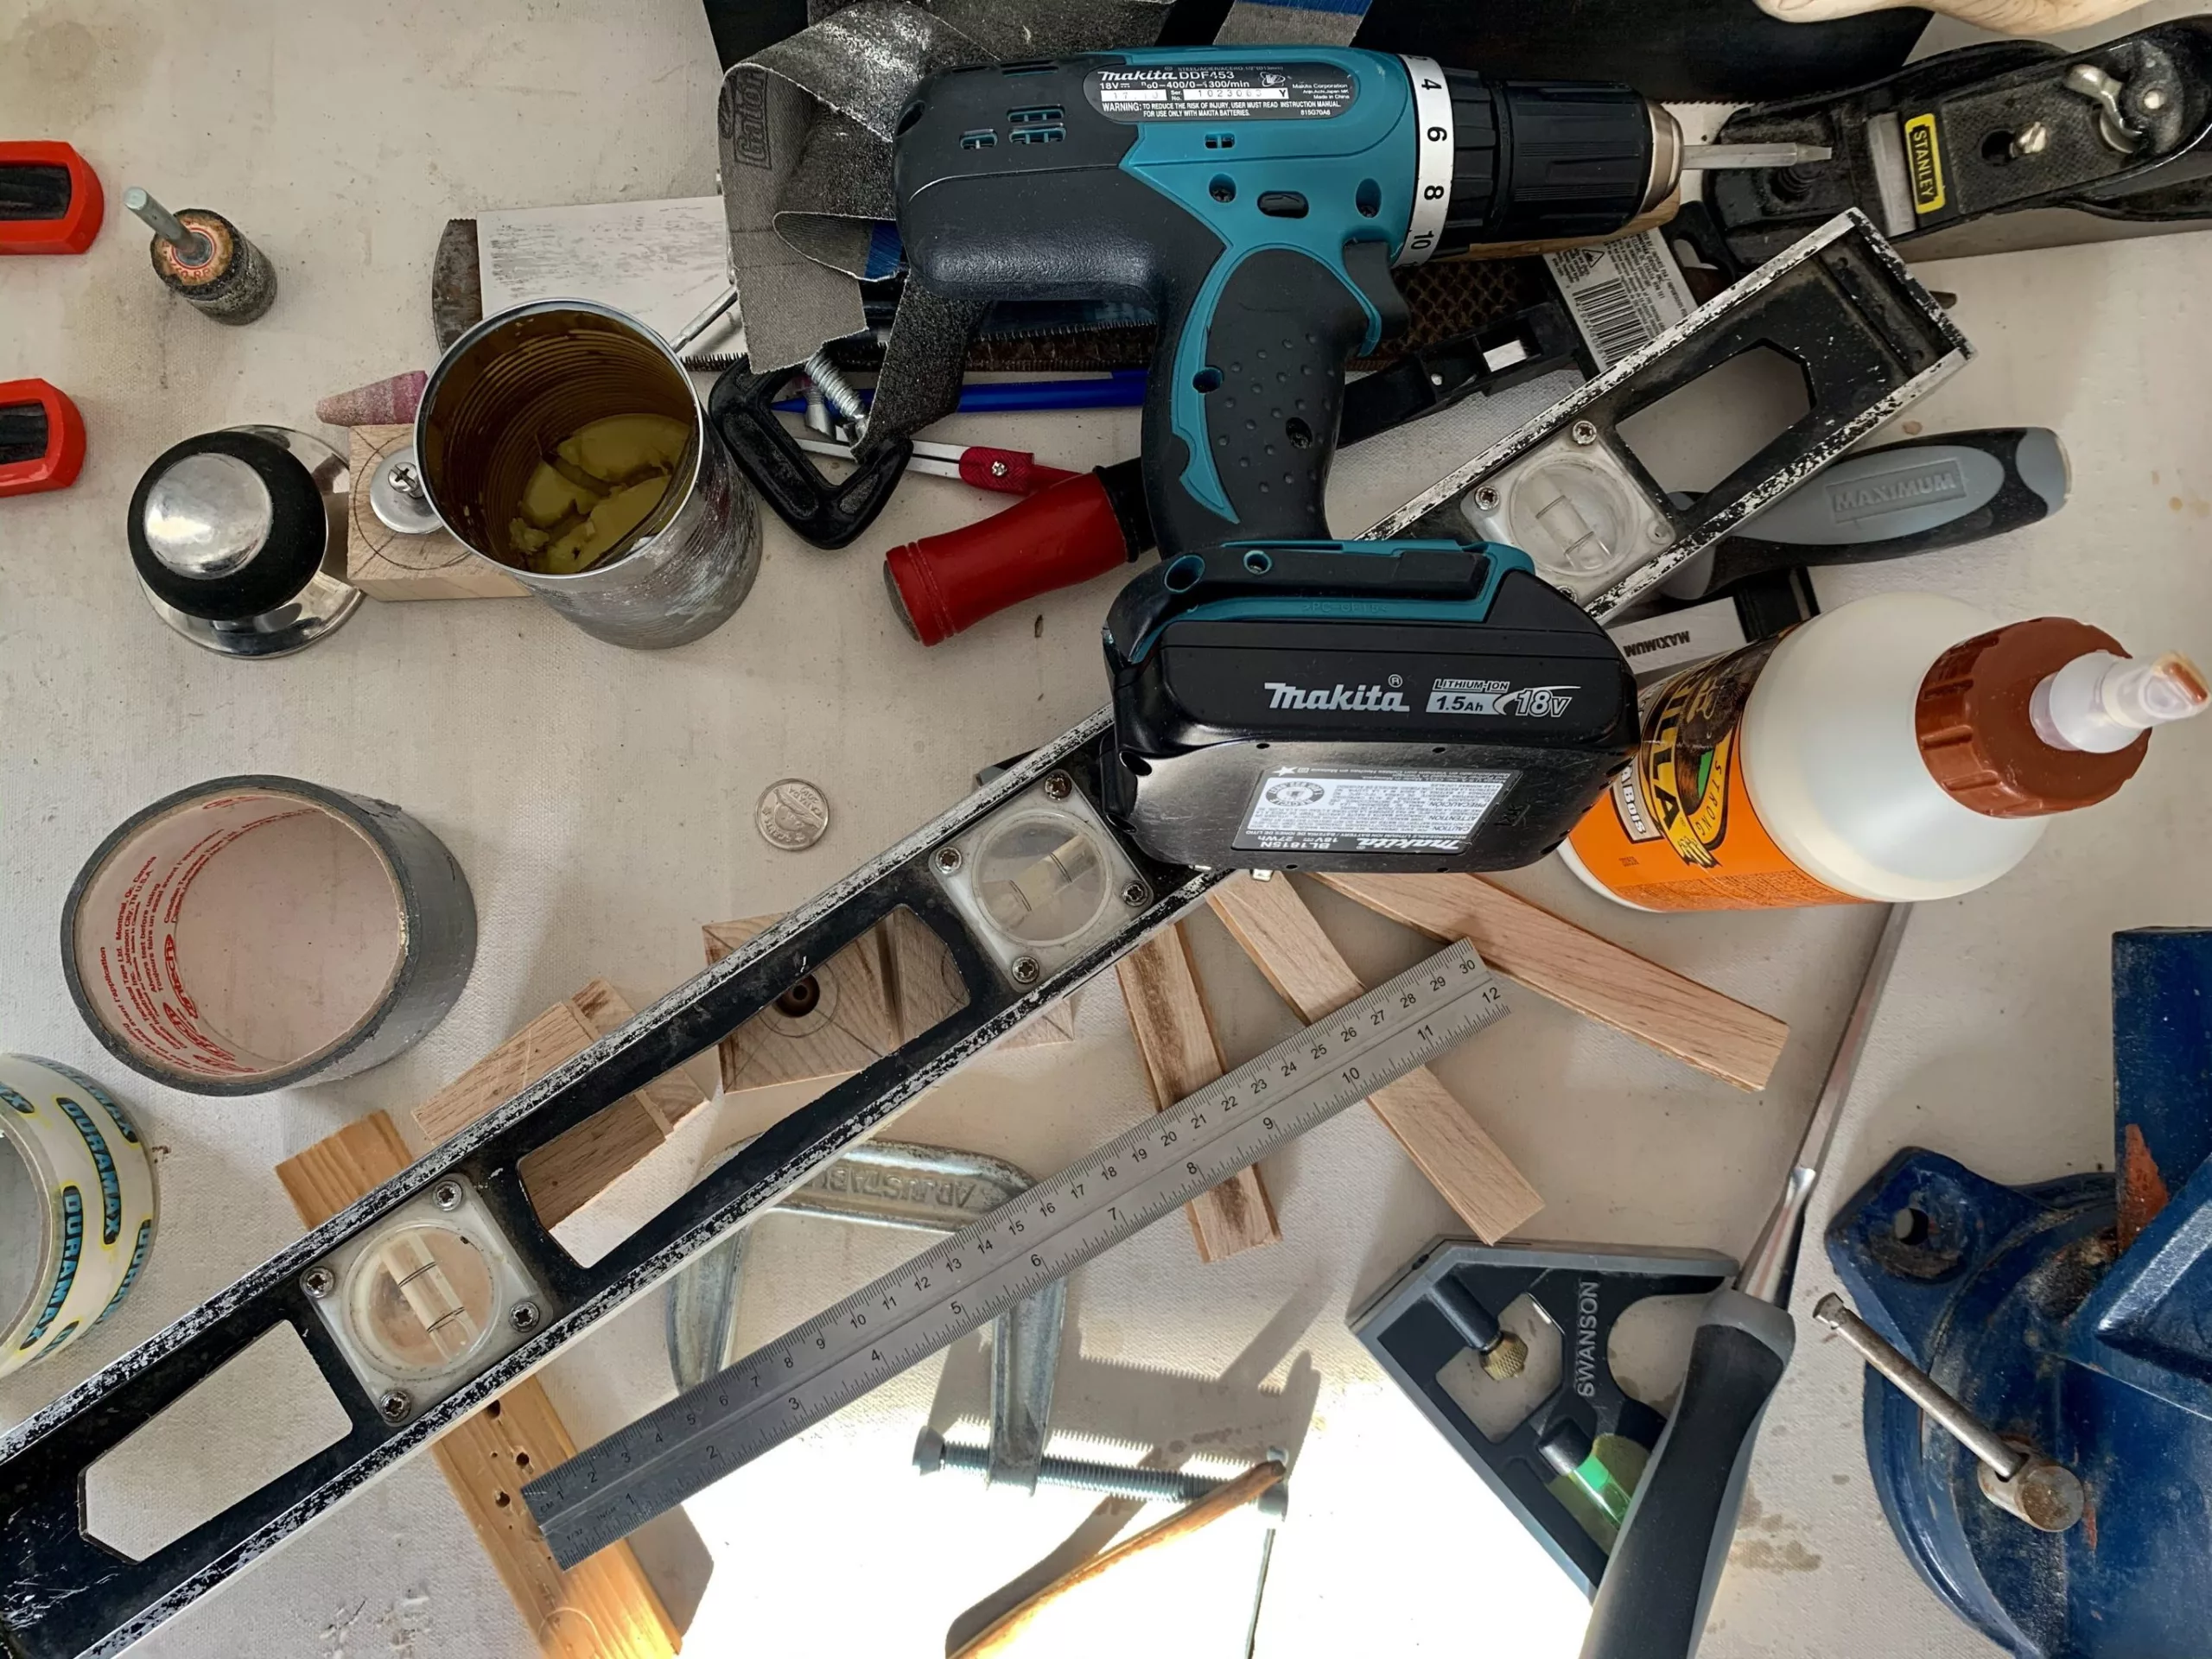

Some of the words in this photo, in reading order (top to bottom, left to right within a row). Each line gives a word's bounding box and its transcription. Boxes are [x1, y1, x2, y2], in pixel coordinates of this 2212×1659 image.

[1179, 71, 1235, 79] DDF453
[1421, 78, 1442, 91] 4
[1102, 102, 1142, 111] WARNING:
[1427, 126, 1448, 143] 6
[1913, 130, 1935, 196] STANLEY
[1423, 185, 1445, 200] 8
[1410, 230, 1434, 251] 10
[1835, 473, 1957, 512] MAXIMUM
[1623, 631, 1691, 658] MAXIMUM
[1435, 696, 1484, 714] 1.5Ah
[1694, 760, 1723, 836] STRONG
[1259, 841, 1332, 850] BL1815N
[145, 882, 162, 909] using
[119, 964, 130, 985] Tape
[132, 855, 157, 884] Canada
[139, 909, 149, 940] before
[124, 927, 134, 966] Johnson
[141, 939, 149, 959] test
[141, 962, 157, 994] Always
[148, 952, 164, 993] Toujours
[59, 1099, 119, 1239] DURAMAX
[539, 1500, 556, 1513] CM
[556, 1491, 565, 1501] 1
[588, 1471, 598, 1484] 2
[620, 1452, 632, 1464] 3
[655, 1433, 664, 1445] 4
[687, 1414, 696, 1426] 5
[719, 1395, 728, 1407] 6
[750, 1376, 761, 1388] 7
[784, 1357, 793, 1369] 8
[816, 1338, 826, 1350] 9
[850, 1314, 867, 1329] 10
[882, 1296, 898, 1310] 11
[914, 1276, 931, 1292] 12
[945, 1258, 963, 1273] 13
[977, 1240, 994, 1254] 14
[1008, 1220, 1025, 1236] 15
[1039, 1202, 1056, 1217] 16
[1071, 1184, 1085, 1199] 17
[1101, 1166, 1117, 1180] 18
[1131, 1148, 1147, 1163] 19
[1160, 1131, 1178, 1147] 20
[1191, 1114, 1207, 1129] 21
[1221, 1096, 1238, 1111] 22
[1250, 1078, 1268, 1094] 23
[1281, 1061, 1297, 1077] 24
[1310, 1044, 1328, 1060] 25
[1340, 1027, 1357, 1043] 26
[1370, 1010, 1386, 1026] 27
[1400, 993, 1417, 1009] 28
[1430, 976, 1446, 992] 29
[1459, 959, 1476, 975] 30
[625, 1492, 636, 1506] 1
[706, 1445, 717, 1459] 2
[788, 1396, 799, 1410] 3
[871, 1349, 880, 1362] 4
[950, 1300, 962, 1315] 5
[1031, 1253, 1041, 1268] 6
[1107, 1207, 1117, 1221] 7
[1186, 1161, 1198, 1175] 8
[1262, 1116, 1274, 1130] 9
[1342, 1066, 1360, 1084] 10
[1417, 1025, 1433, 1041] 11
[1482, 986, 1501, 1004] 12
[29, 1193, 83, 1344] DURAMAX
[1577, 1281, 1599, 1397] SWANSON
